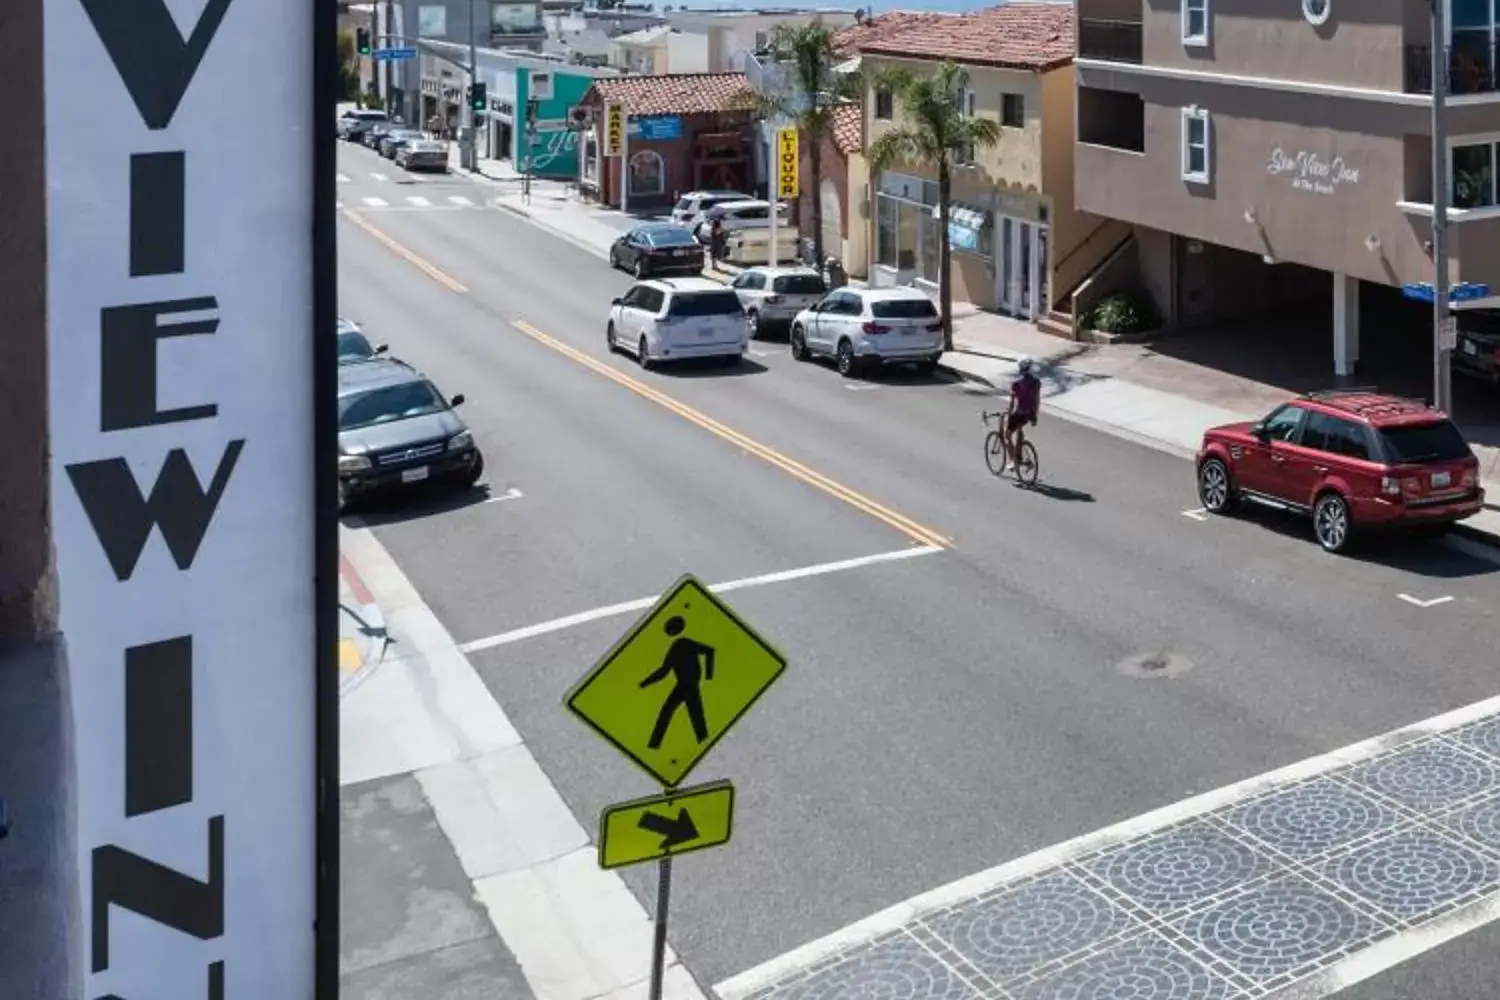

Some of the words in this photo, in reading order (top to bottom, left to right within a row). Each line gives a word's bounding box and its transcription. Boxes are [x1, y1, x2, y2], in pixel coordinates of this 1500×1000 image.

[610, 105, 622, 153] MARKET
[782, 130, 795, 196] LIQUOR
[1266, 147, 1296, 176] Sea
[1296, 150, 1331, 178] View
[1331, 154, 1360, 185] Inn
[91, 633, 225, 1000] IN
